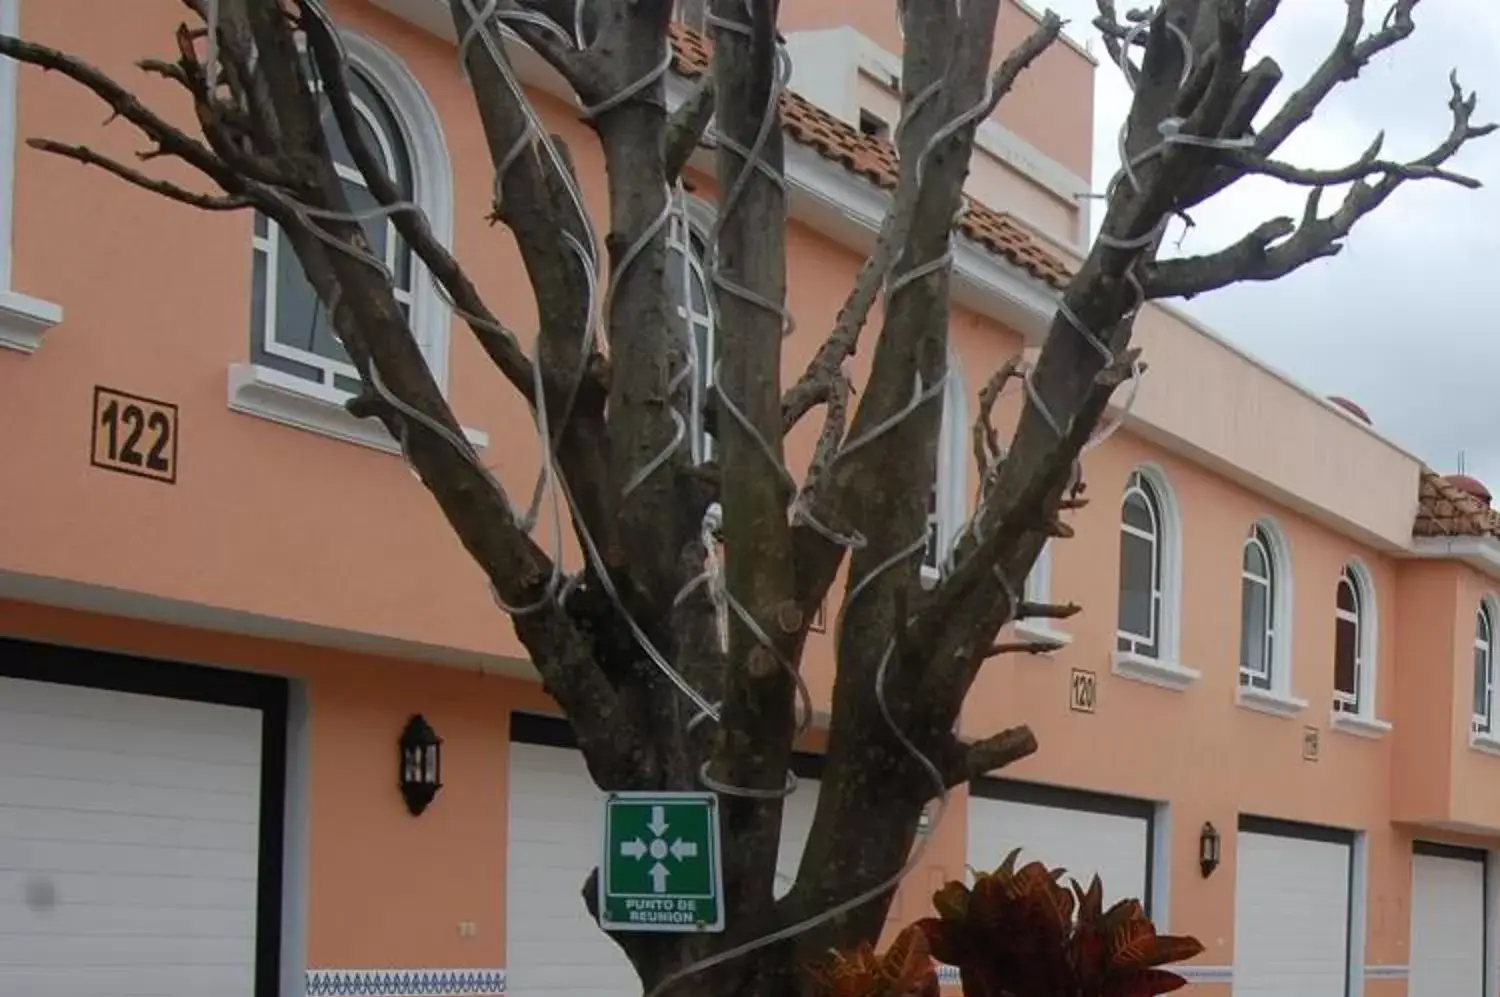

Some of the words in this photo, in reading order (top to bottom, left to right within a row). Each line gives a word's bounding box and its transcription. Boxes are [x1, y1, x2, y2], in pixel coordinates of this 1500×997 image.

[101, 399, 169, 472] 122
[626, 899, 674, 911] PUNTO
[677, 899, 696, 911] DE
